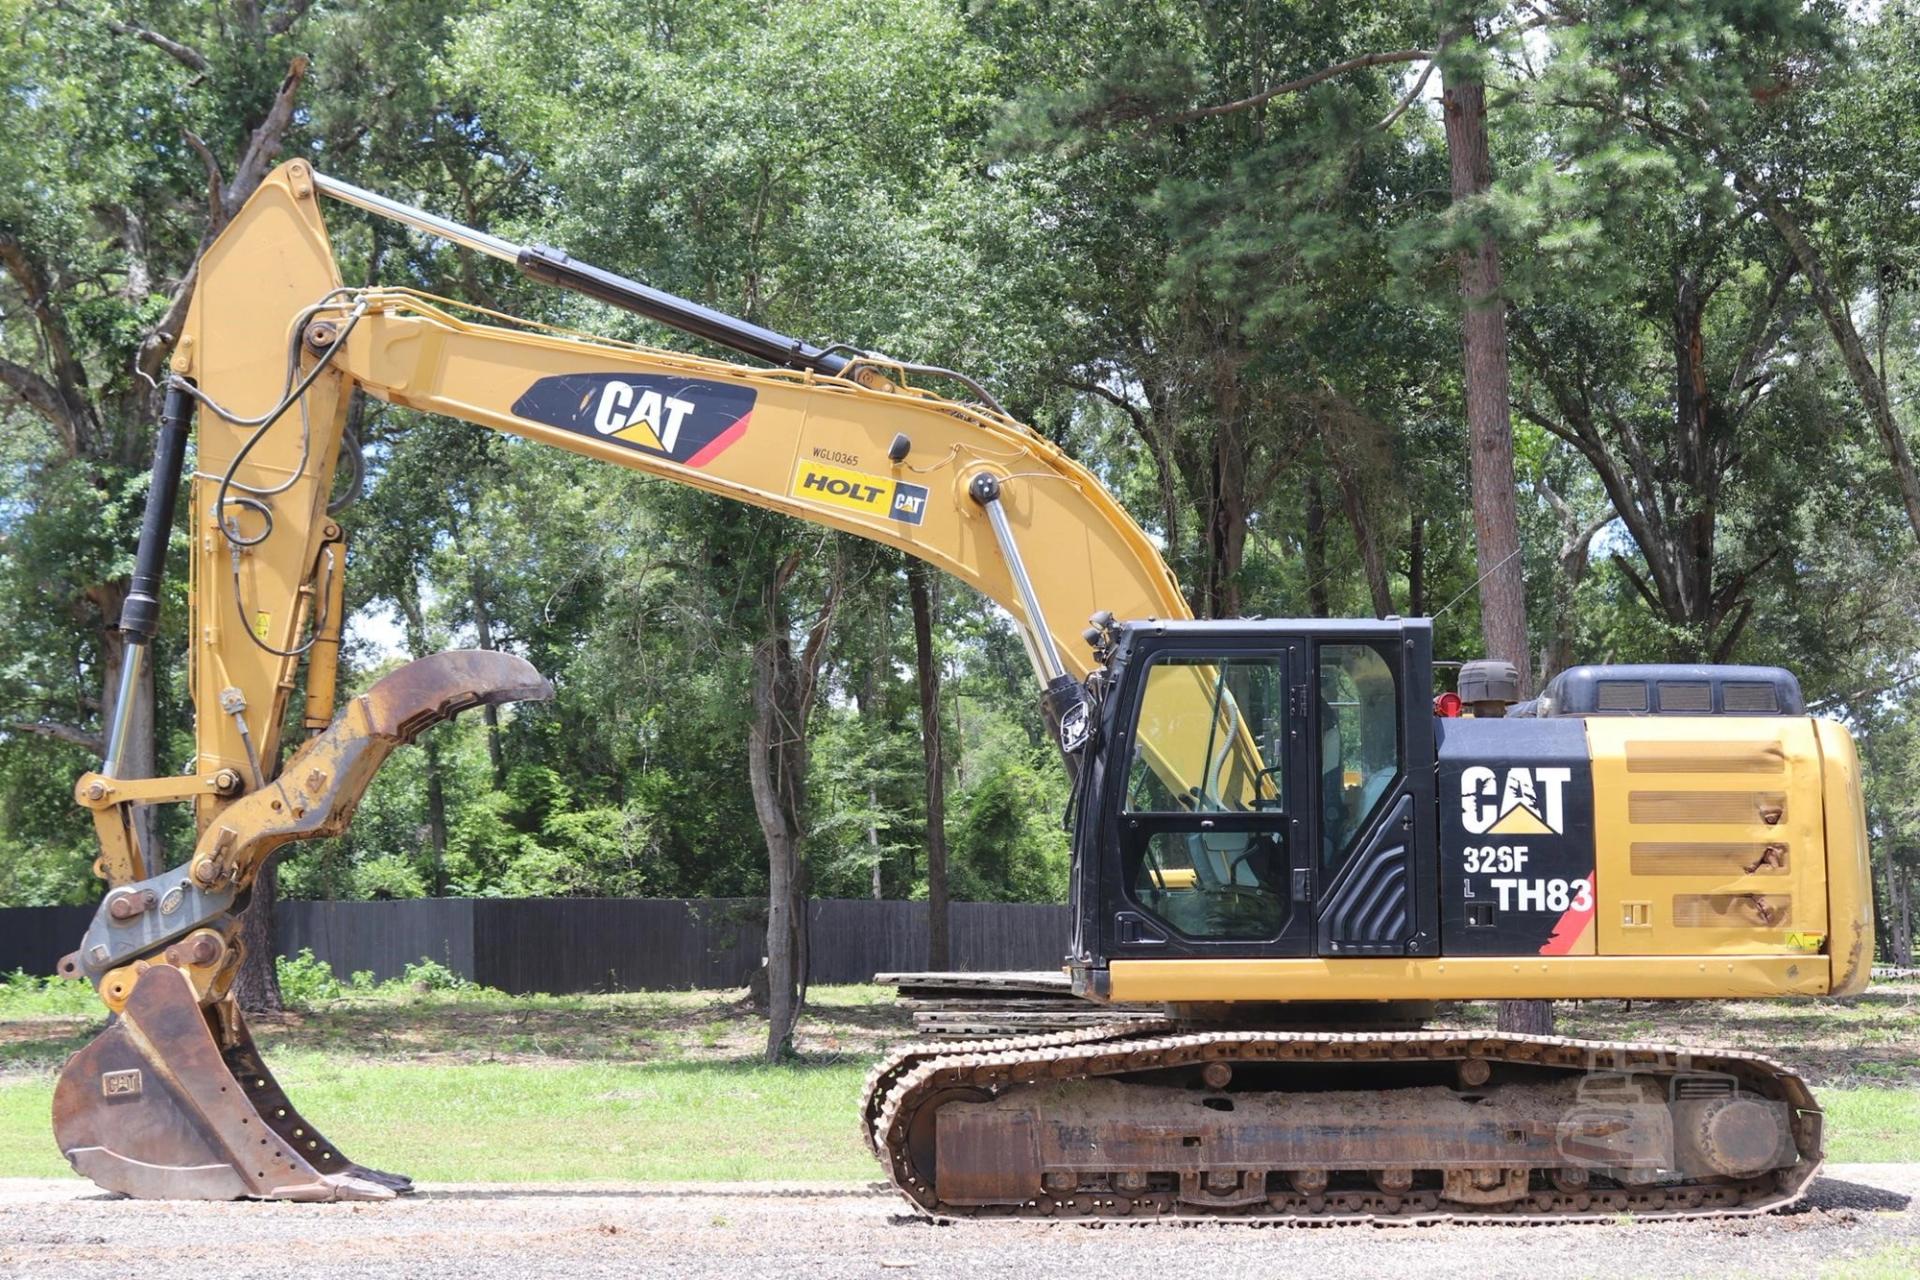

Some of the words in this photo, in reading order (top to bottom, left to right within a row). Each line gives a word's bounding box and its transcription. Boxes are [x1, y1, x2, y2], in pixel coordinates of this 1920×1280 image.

[594, 380, 695, 454] CAT
[803, 472, 885, 503] HOLT
[895, 493, 924, 514] CAT
[1461, 766, 1571, 835] CAT
[1491, 878, 1593, 912] TH83
